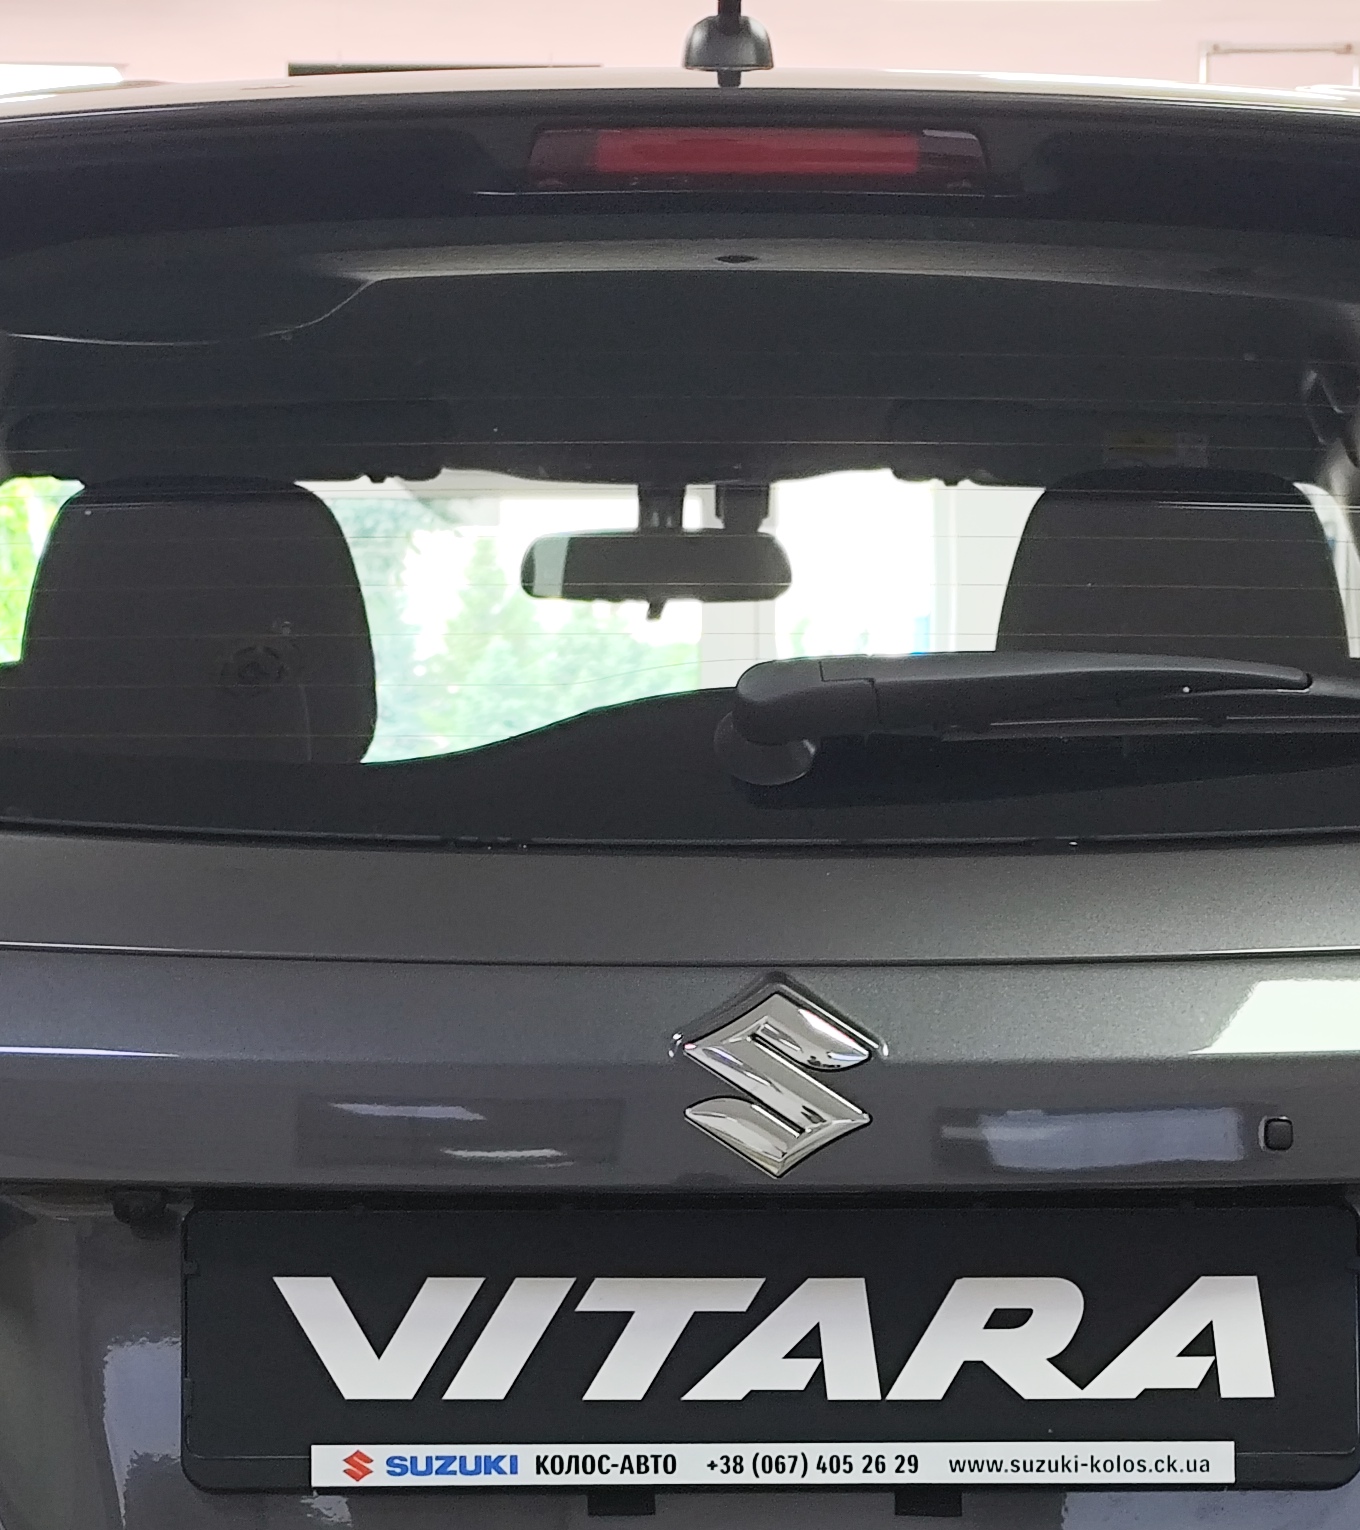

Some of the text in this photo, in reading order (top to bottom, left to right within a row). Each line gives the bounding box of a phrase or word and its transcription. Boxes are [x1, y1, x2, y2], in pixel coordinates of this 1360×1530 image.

[272, 1275, 1276, 1401] VITARA
[385, 1454, 519, 1477] SUZUKI
[534, 1453, 678, 1476] КОЛОС-АВТО
[706, 1453, 920, 1477] +38 (067) 405 26 29
[948, 1454, 1211, 1475] www.suzuki-kolos.ck.ua
